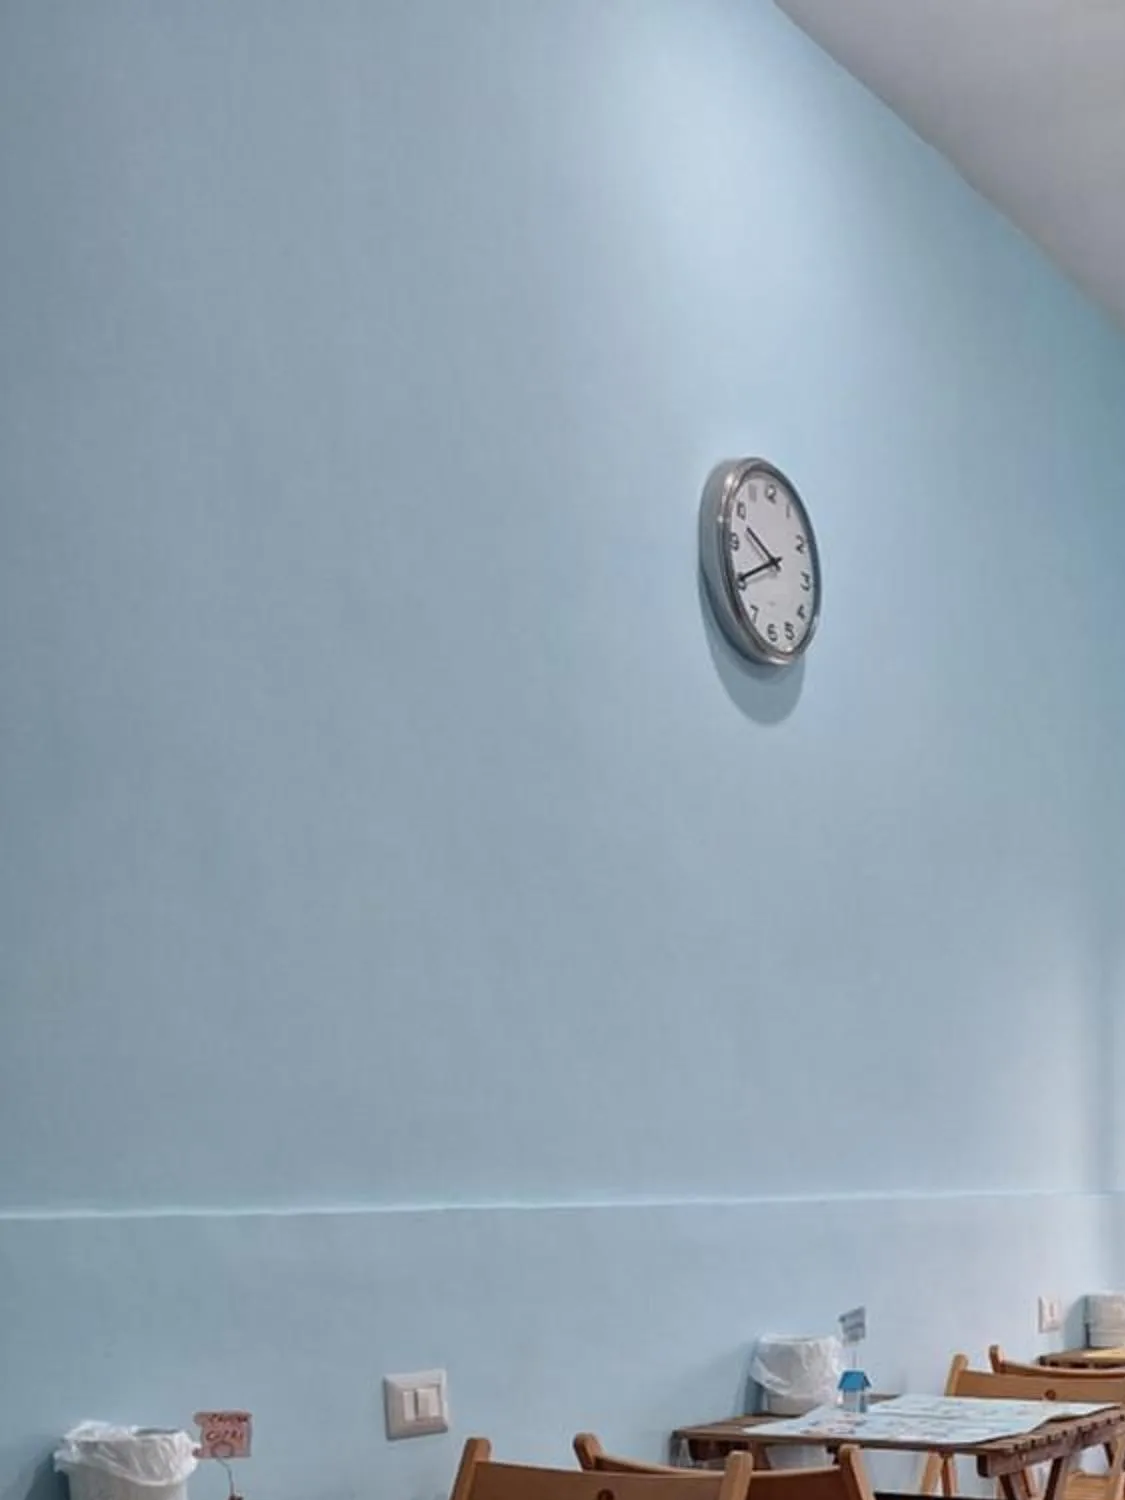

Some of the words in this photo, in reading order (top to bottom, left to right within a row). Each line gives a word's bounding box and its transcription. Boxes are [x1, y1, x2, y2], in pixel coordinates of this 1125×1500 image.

[795, 534, 806, 554] 2
[800, 572, 810, 591] 3
[750, 605, 758, 624] 7
[796, 604, 806, 619] 4
[767, 623, 777, 642] 6
[784, 621, 795, 640] 5
